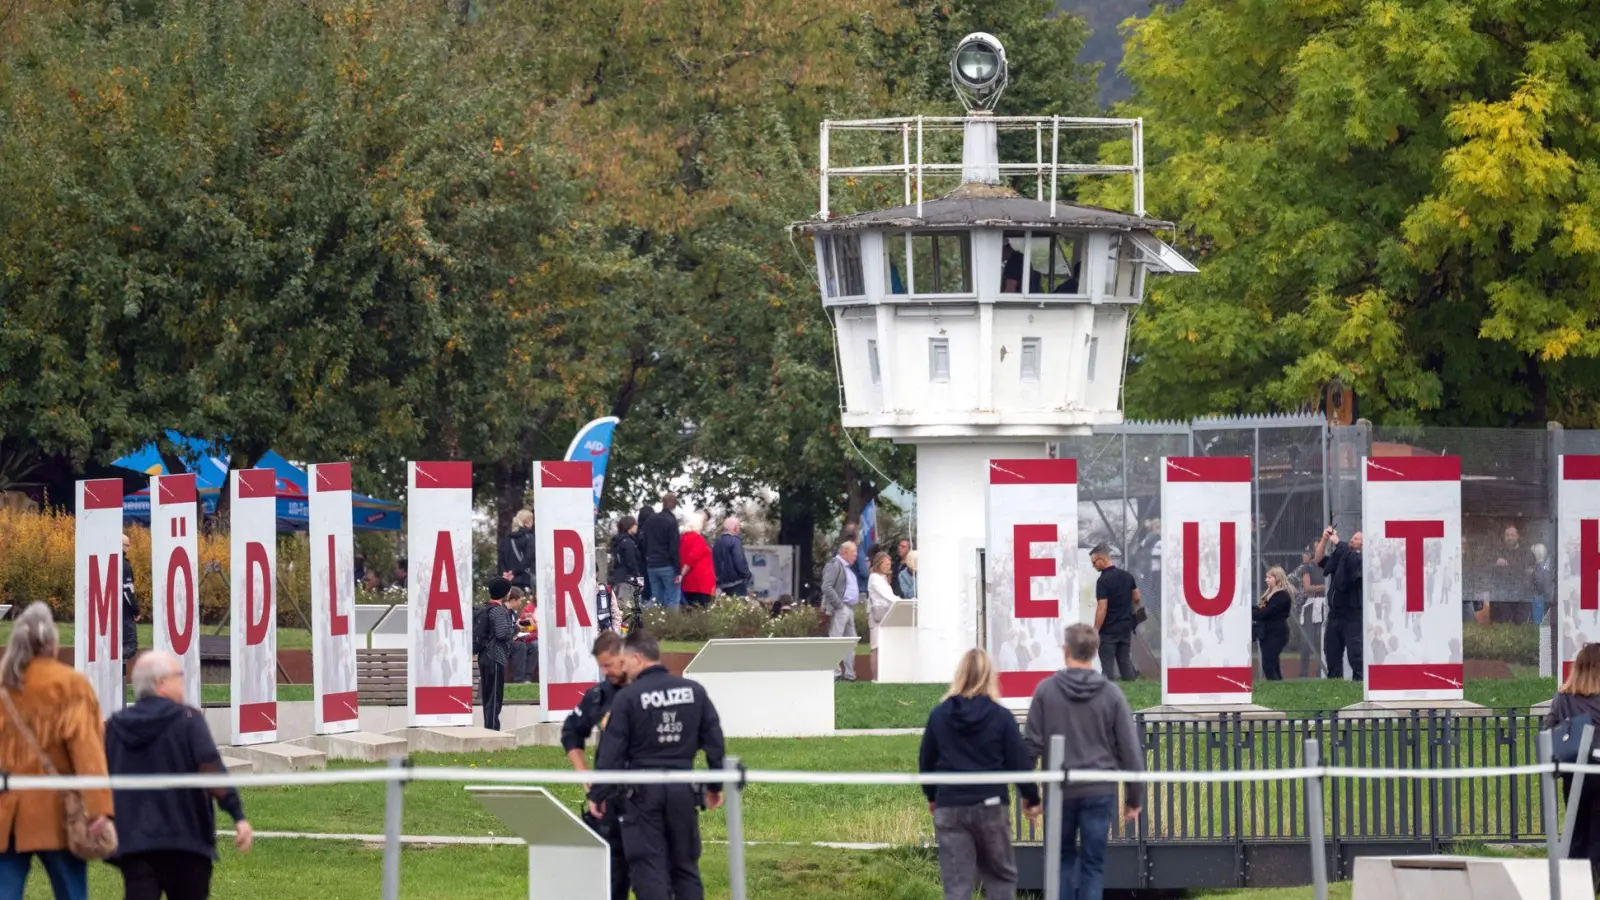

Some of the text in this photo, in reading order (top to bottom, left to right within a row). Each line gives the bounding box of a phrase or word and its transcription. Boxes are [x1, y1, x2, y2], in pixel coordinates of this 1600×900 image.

[584, 440, 604, 451] AfD
[641, 687, 694, 709] POLIZEI
[662, 711, 677, 722] BY
[656, 722, 683, 733] 4430
